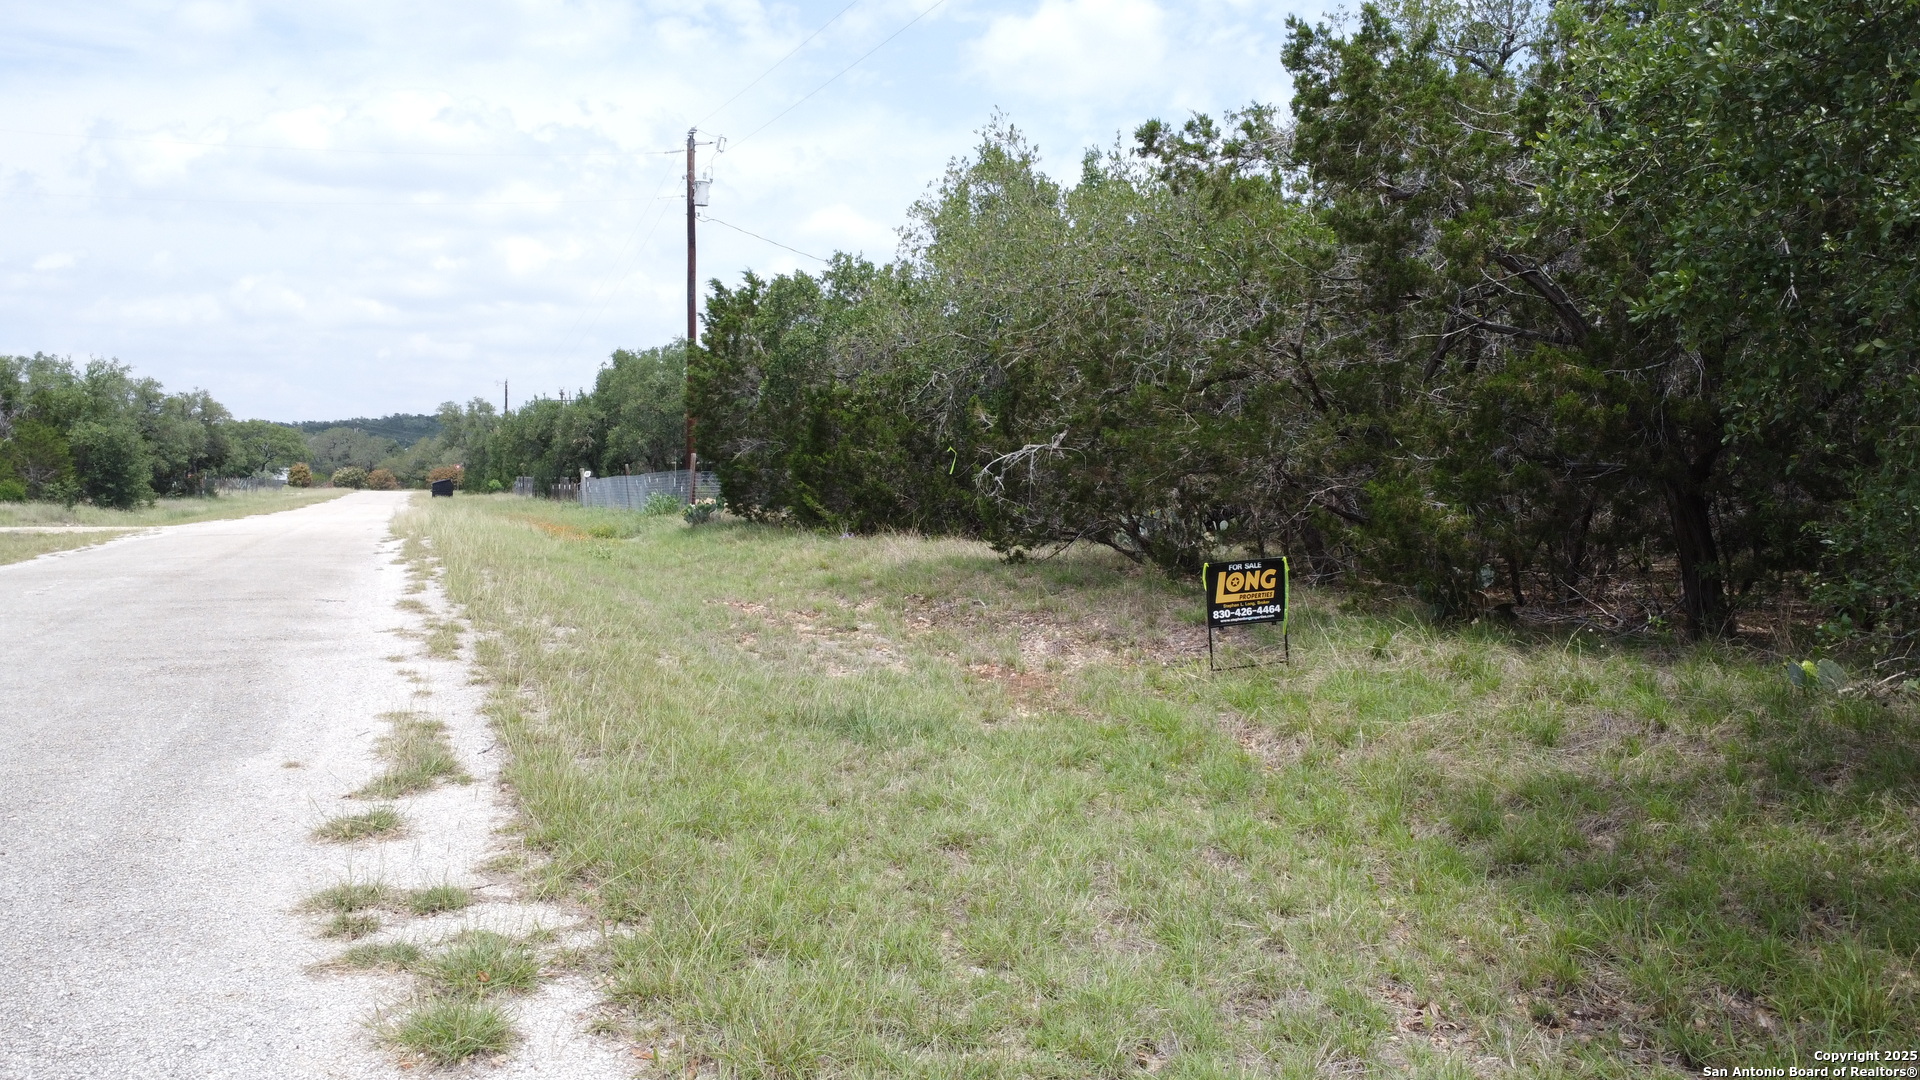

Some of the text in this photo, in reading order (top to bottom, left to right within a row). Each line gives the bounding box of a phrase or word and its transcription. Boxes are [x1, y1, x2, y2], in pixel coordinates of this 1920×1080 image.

[1215, 568, 1277, 604] LONG
[1239, 591, 1273, 600] PROPERTIES
[1212, 605, 1281, 619] 830-426-4464
